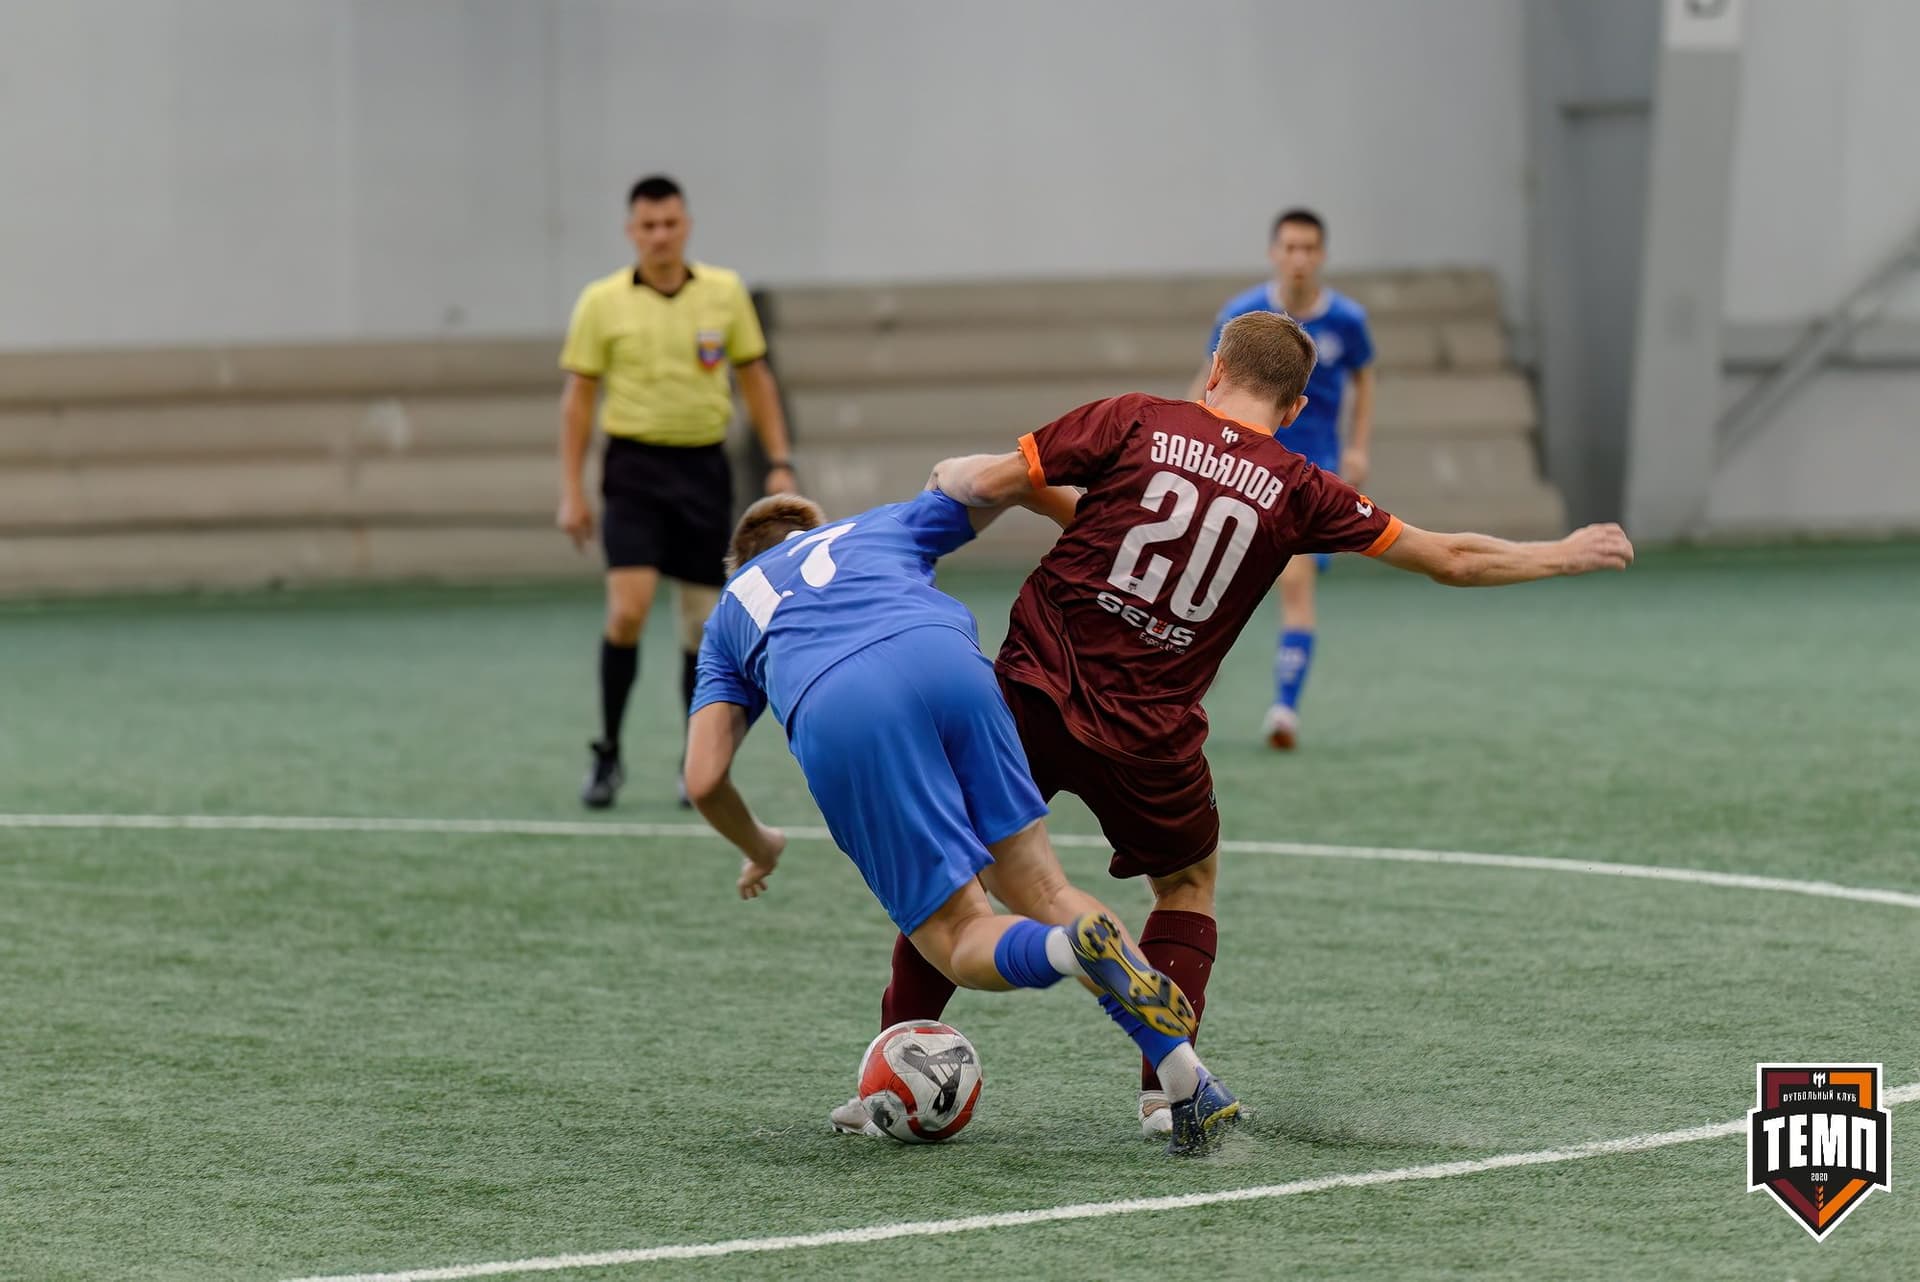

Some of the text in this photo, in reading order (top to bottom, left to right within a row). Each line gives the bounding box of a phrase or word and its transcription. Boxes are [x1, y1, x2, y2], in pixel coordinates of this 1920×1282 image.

[1151, 431, 1283, 510] ЗАВЬЯЛОВ
[1106, 470, 1259, 622] 20
[1096, 591, 1196, 647] SEUS
